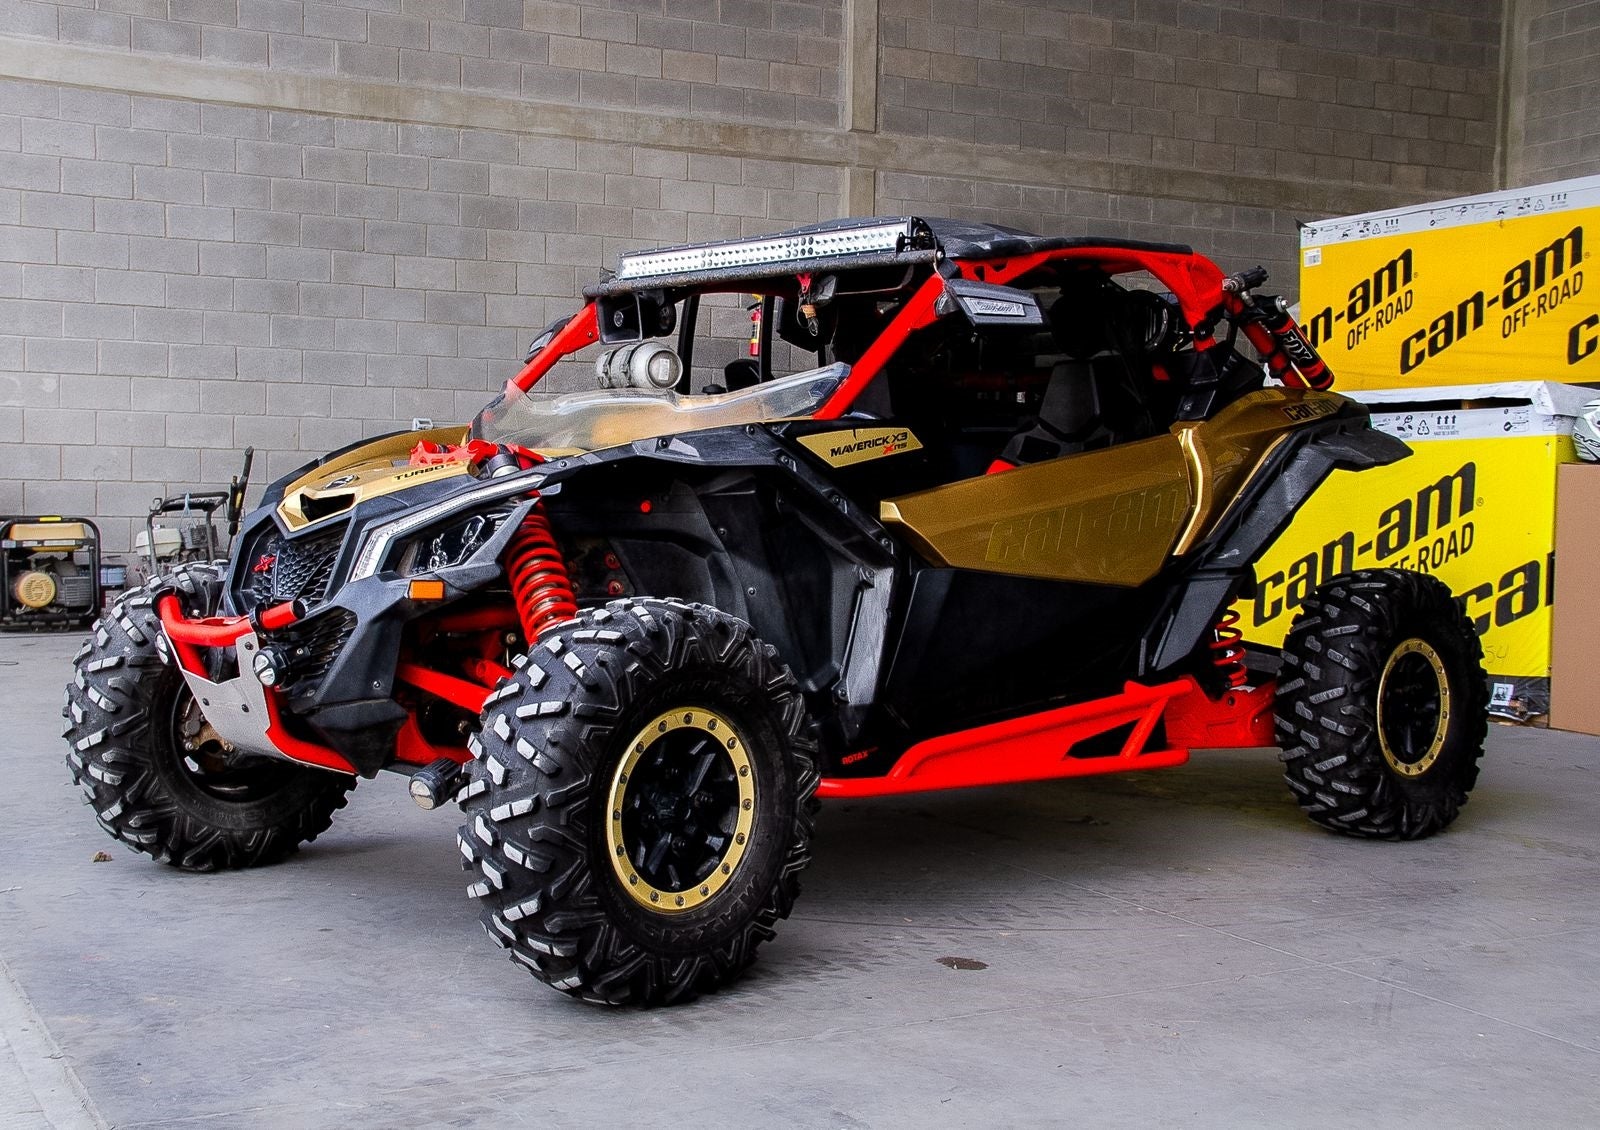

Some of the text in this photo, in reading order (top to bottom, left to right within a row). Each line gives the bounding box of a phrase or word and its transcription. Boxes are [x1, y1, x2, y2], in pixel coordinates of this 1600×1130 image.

[1301, 249, 1412, 349] n-am
[1347, 289, 1413, 350] OFF-ROAD
[1401, 226, 1583, 375] can-am
[1502, 271, 1583, 339] OFF-ROAD
[394, 464, 445, 480] TURBO
[830, 432, 908, 457] MAVERICK X3
[1253, 462, 1476, 627] can-am
